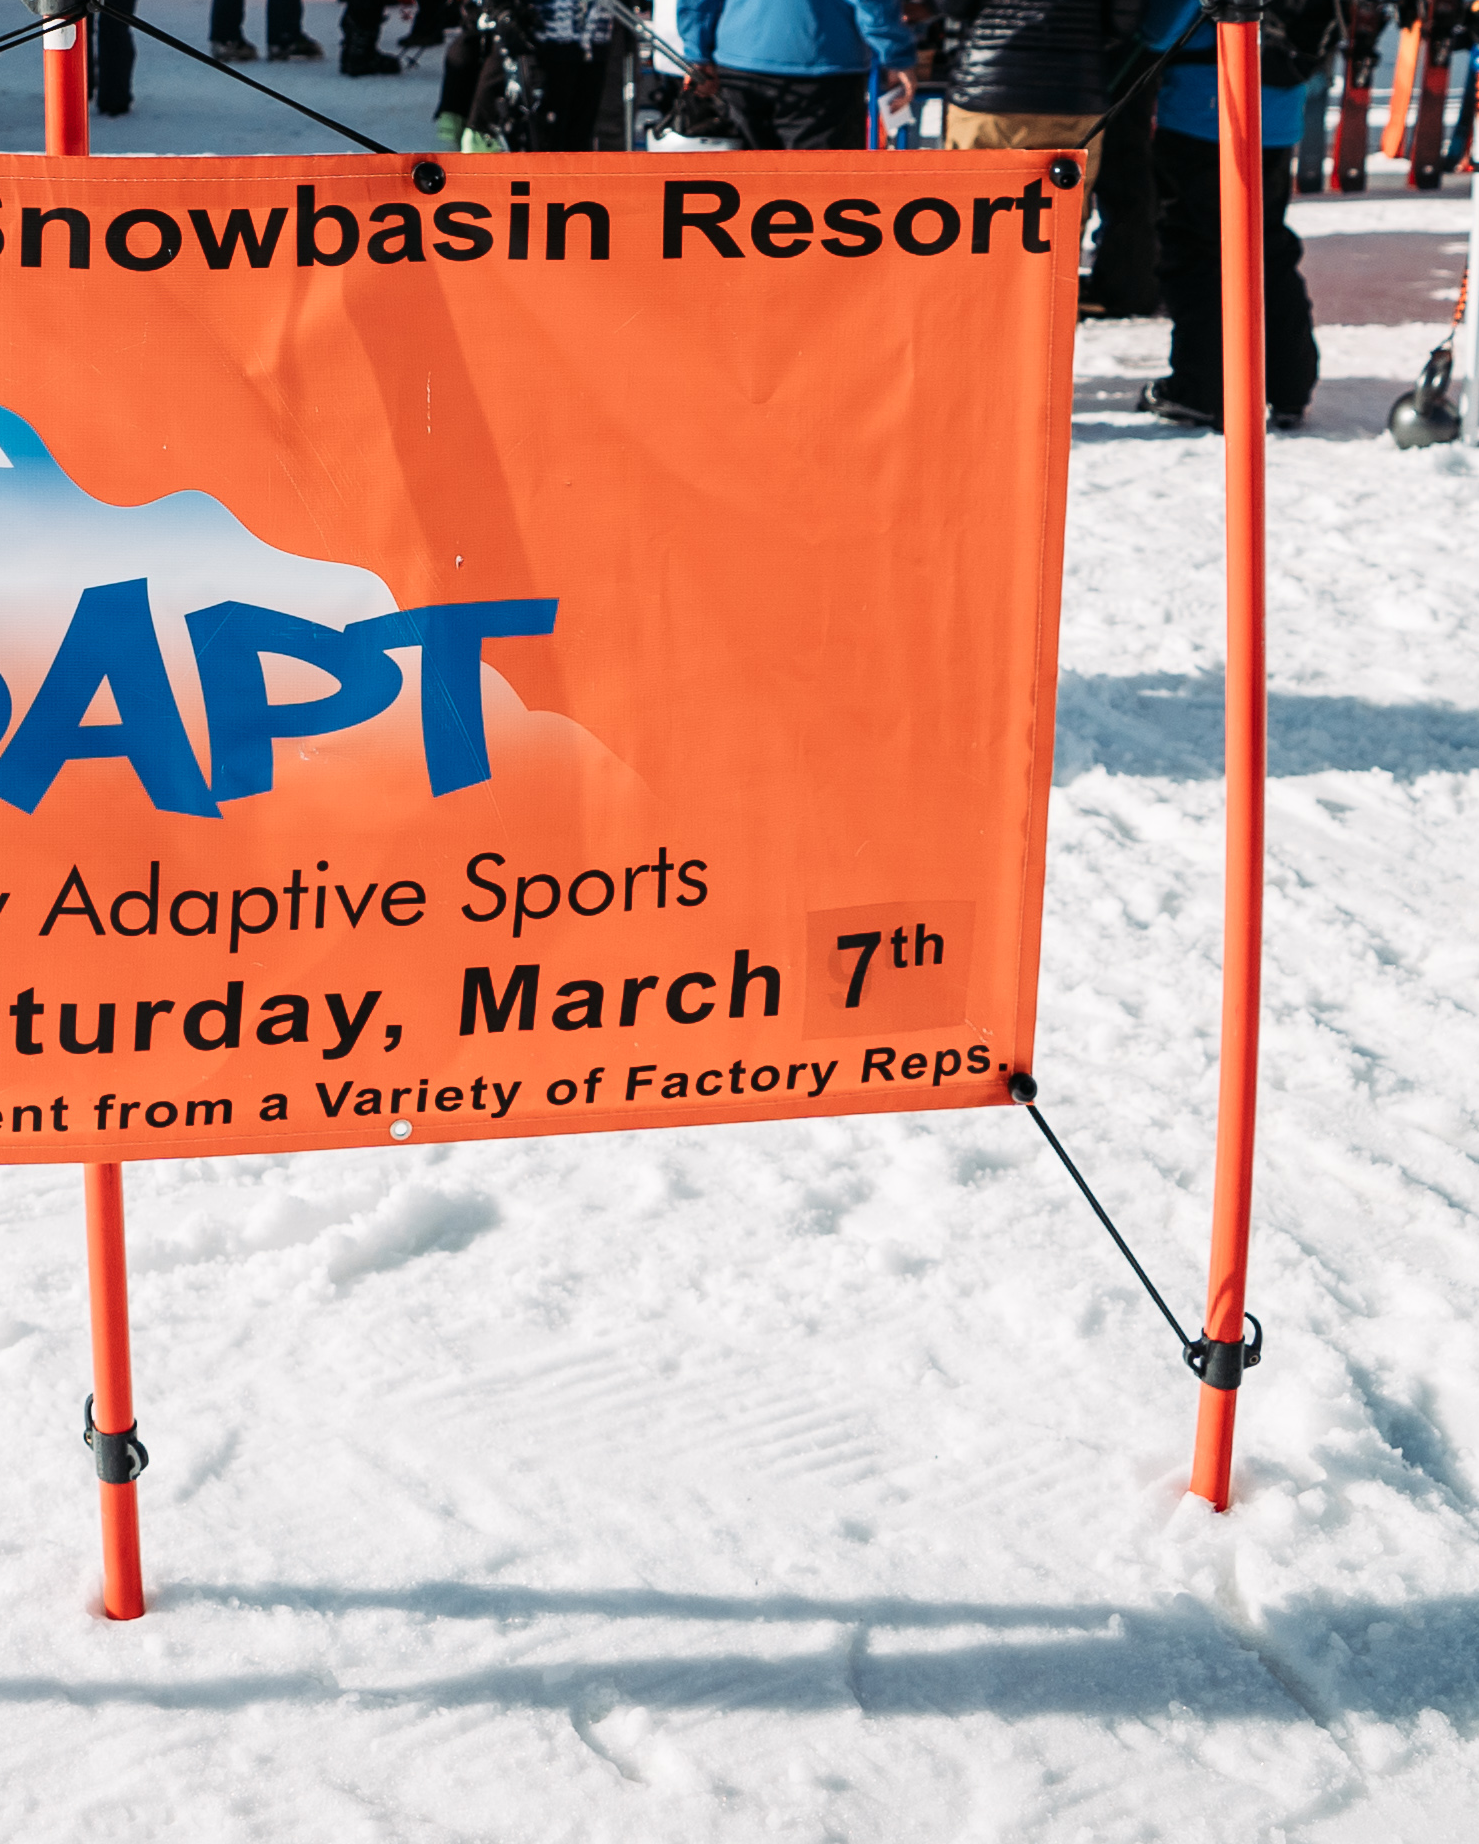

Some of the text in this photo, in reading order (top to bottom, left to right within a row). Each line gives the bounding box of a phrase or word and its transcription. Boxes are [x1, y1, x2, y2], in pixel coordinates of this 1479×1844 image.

[663, 178, 1052, 258] Resort
[39, 861, 425, 953] Adaptive
[462, 847, 707, 938] Sports
[460, 950, 780, 1036] March
[838, 924, 943, 1008] 7th
[94, 1094, 232, 1129] from
[260, 1094, 287, 1121] a
[316, 1077, 521, 1118] Variety
[547, 1068, 604, 1105] of
[626, 1060, 838, 1100] Factory
[862, 1045, 1007, 1086] Reps.
